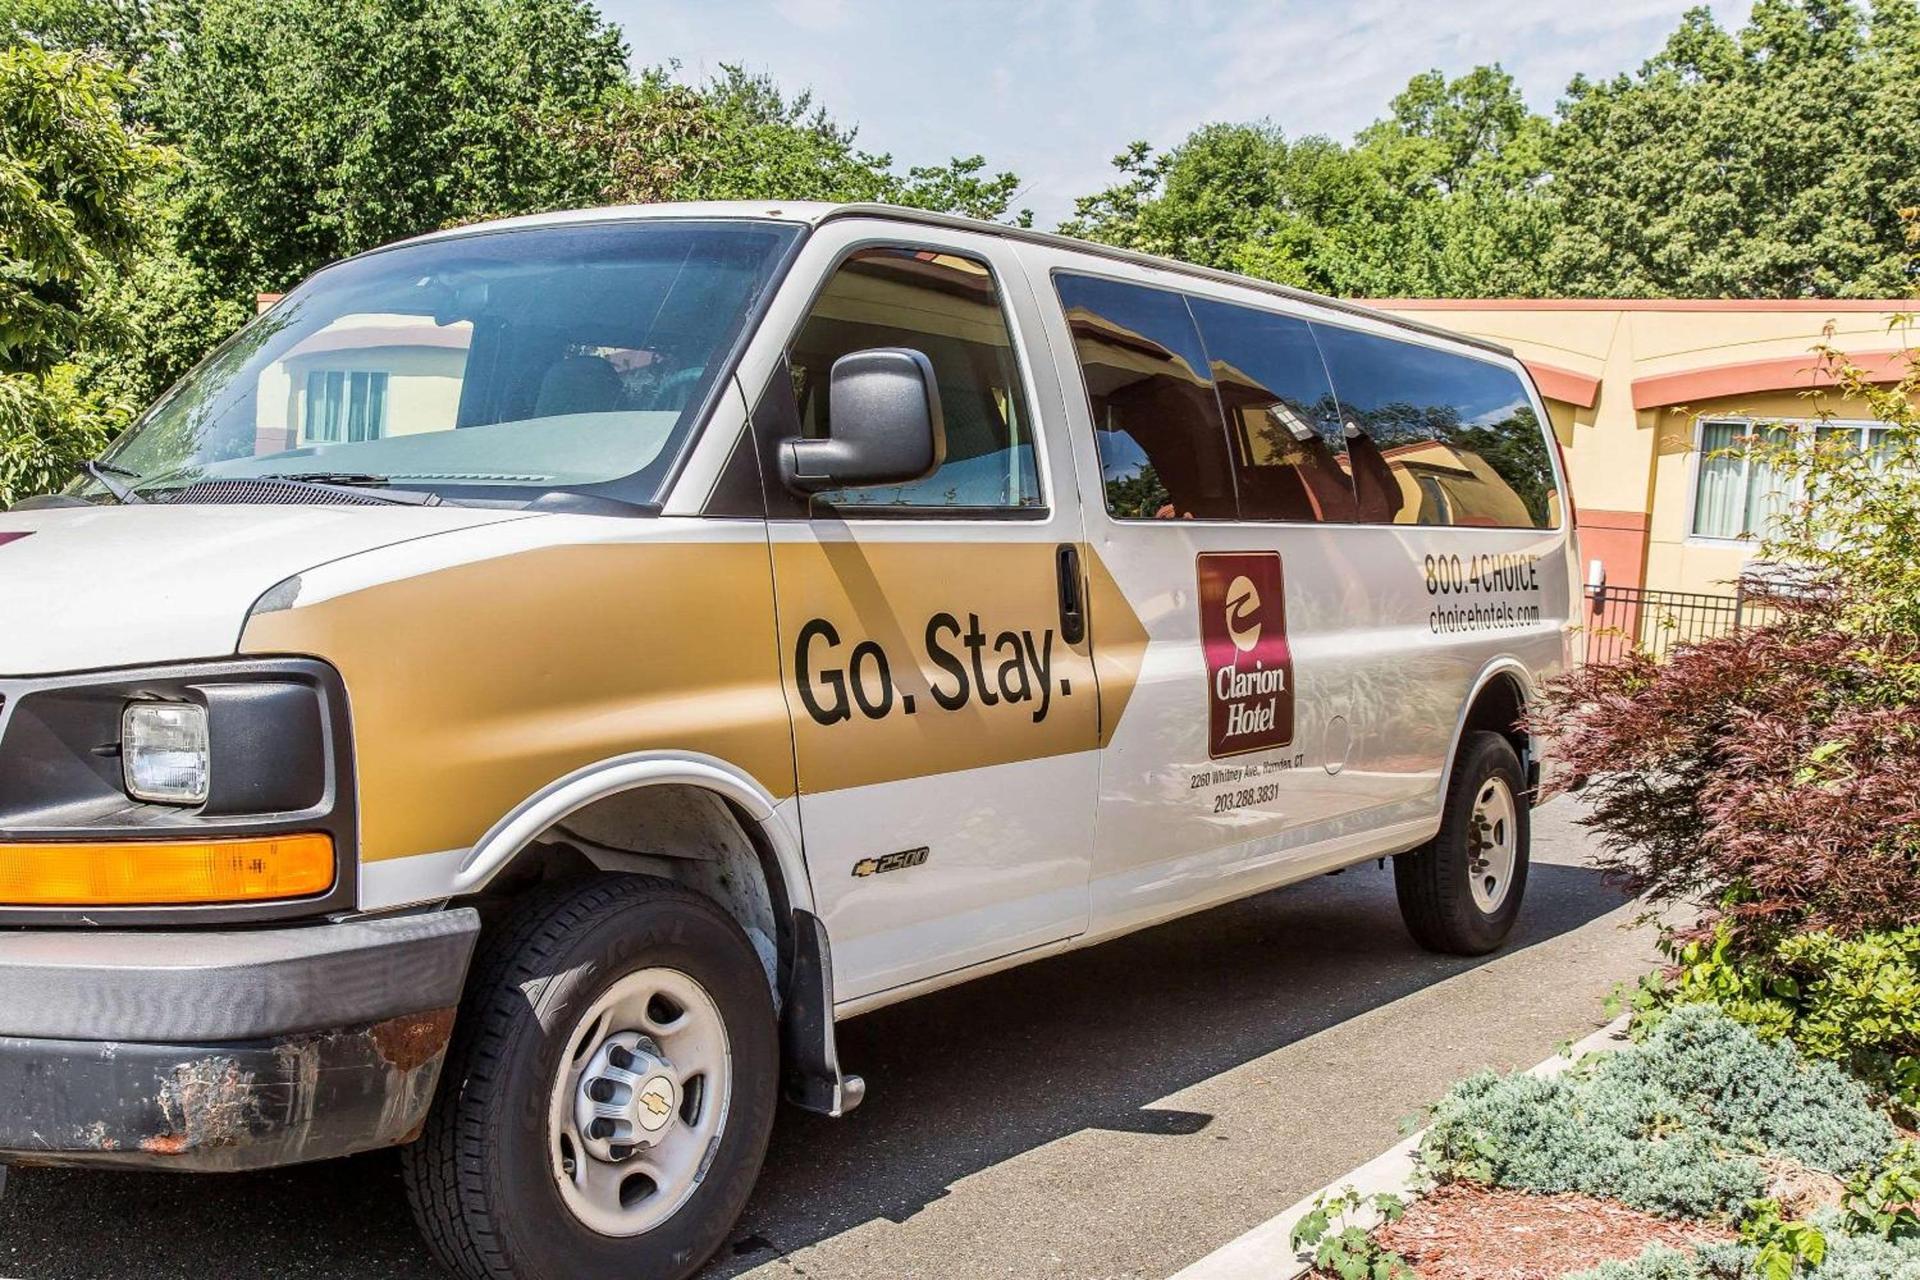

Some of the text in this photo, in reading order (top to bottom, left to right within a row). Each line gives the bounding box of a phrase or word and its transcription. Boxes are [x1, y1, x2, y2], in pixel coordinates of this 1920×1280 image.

[1425, 554, 1538, 595] 800.4CHOICE
[1430, 601, 1540, 634] choicehotels.com
[794, 612, 1072, 726] Go. Stay.
[1216, 660, 1285, 700] Clarion
[1226, 697, 1276, 736] Hotel
[1191, 774, 1210, 789] 2260
[1213, 768, 1243, 783] Whitney
[1294, 754, 1304, 768] CT
[1214, 782, 1280, 813] 203.288.3831
[878, 847, 930, 873] 2500
